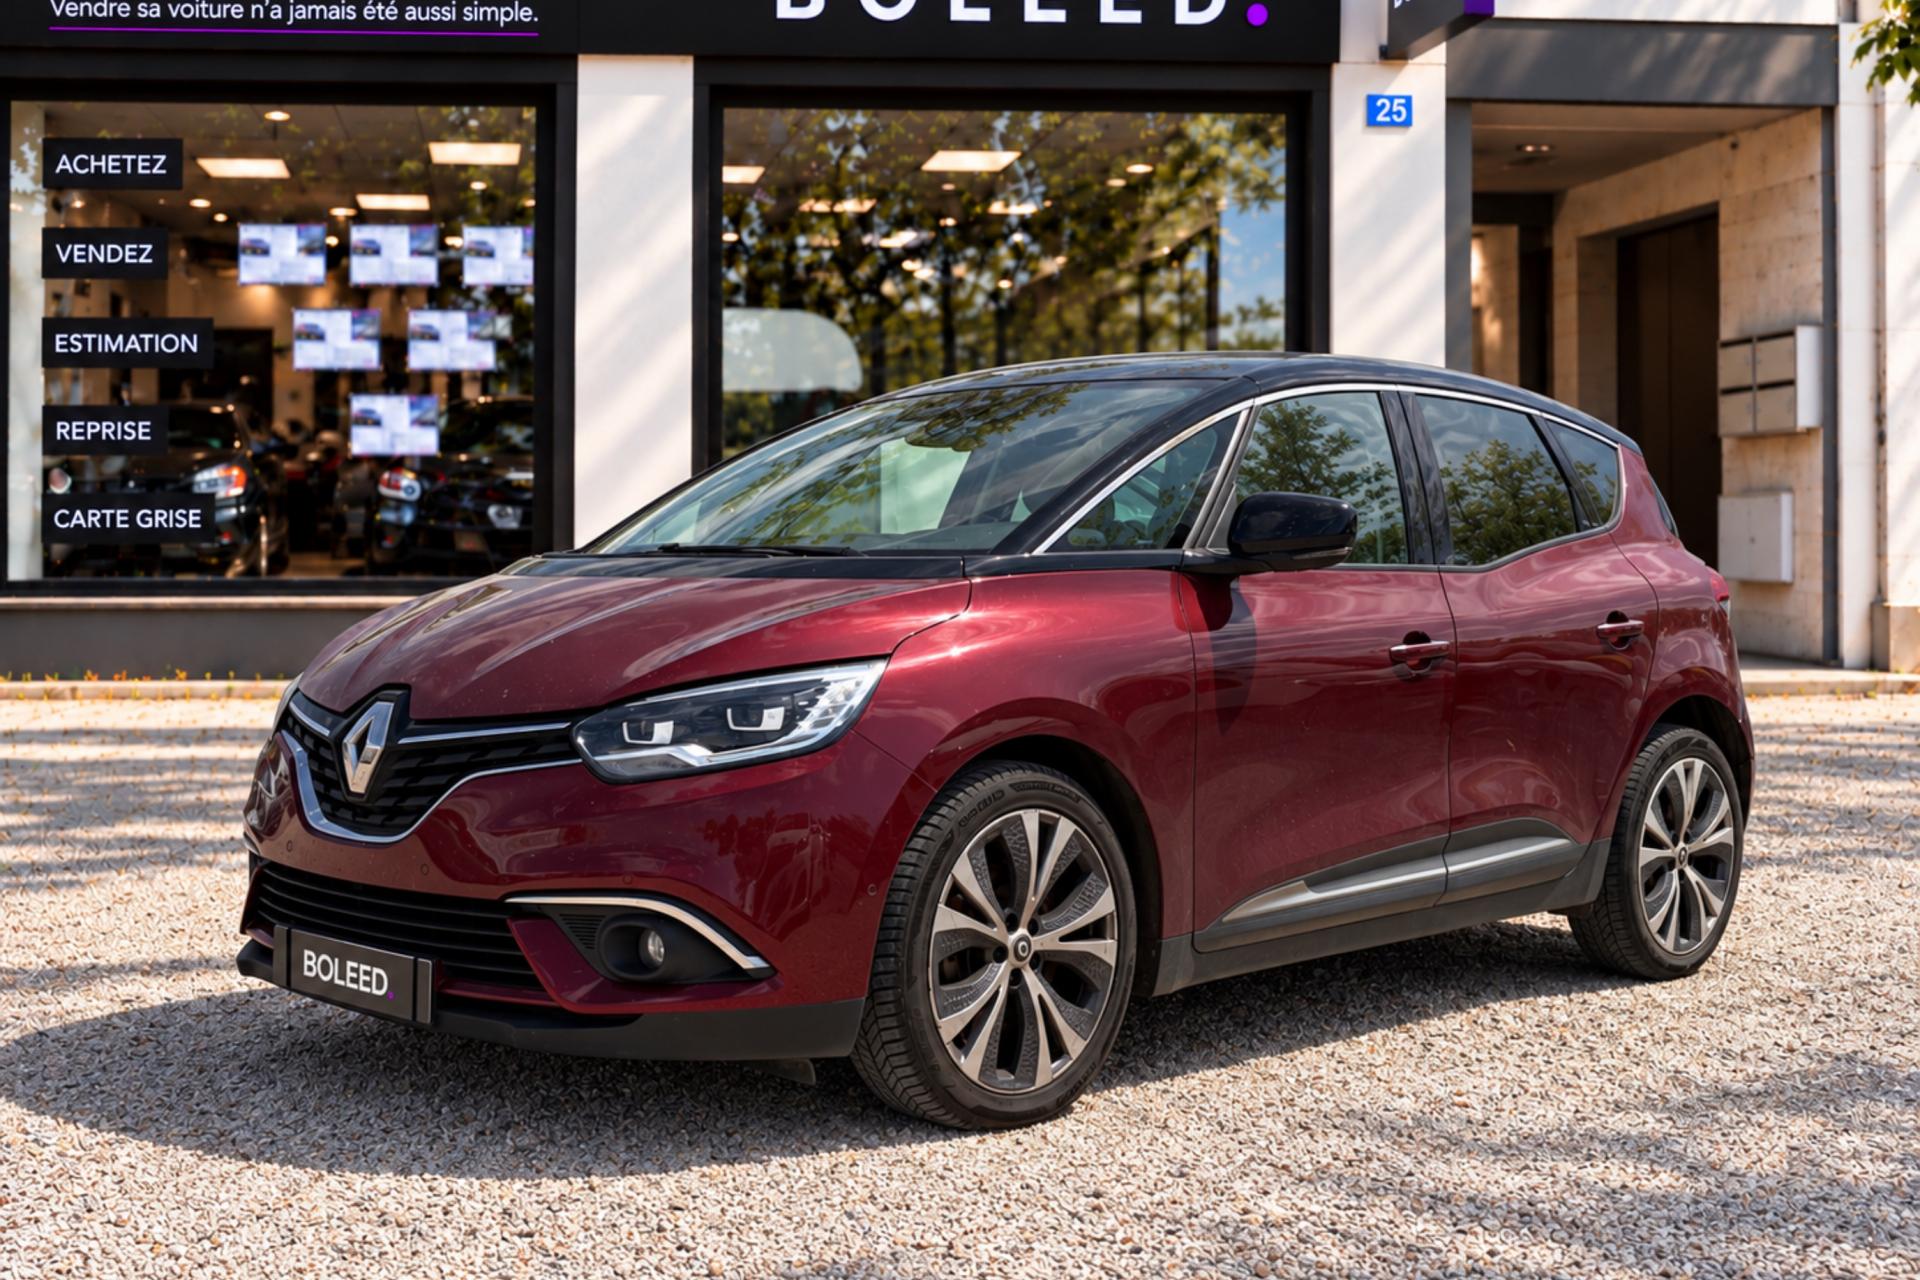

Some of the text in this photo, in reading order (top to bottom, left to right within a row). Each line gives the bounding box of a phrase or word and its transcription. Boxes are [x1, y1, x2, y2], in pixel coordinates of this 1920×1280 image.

[50, 0, 131, 18] Vendre
[137, 3, 161, 18] sa
[168, 0, 244, 19] voiture
[286, 0, 357, 25] jamais
[363, 0, 399, 21] été
[404, 1, 457, 21] aussi
[462, 1, 539, 28] simple.
[1376, 98, 1408, 123] 25
[55, 154, 167, 175] ACHETEZ
[55, 243, 153, 264] VENDEZ
[55, 333, 198, 354] ESTIMATION
[56, 421, 152, 441] REPRISE
[53, 508, 202, 529] CARTE GRISE
